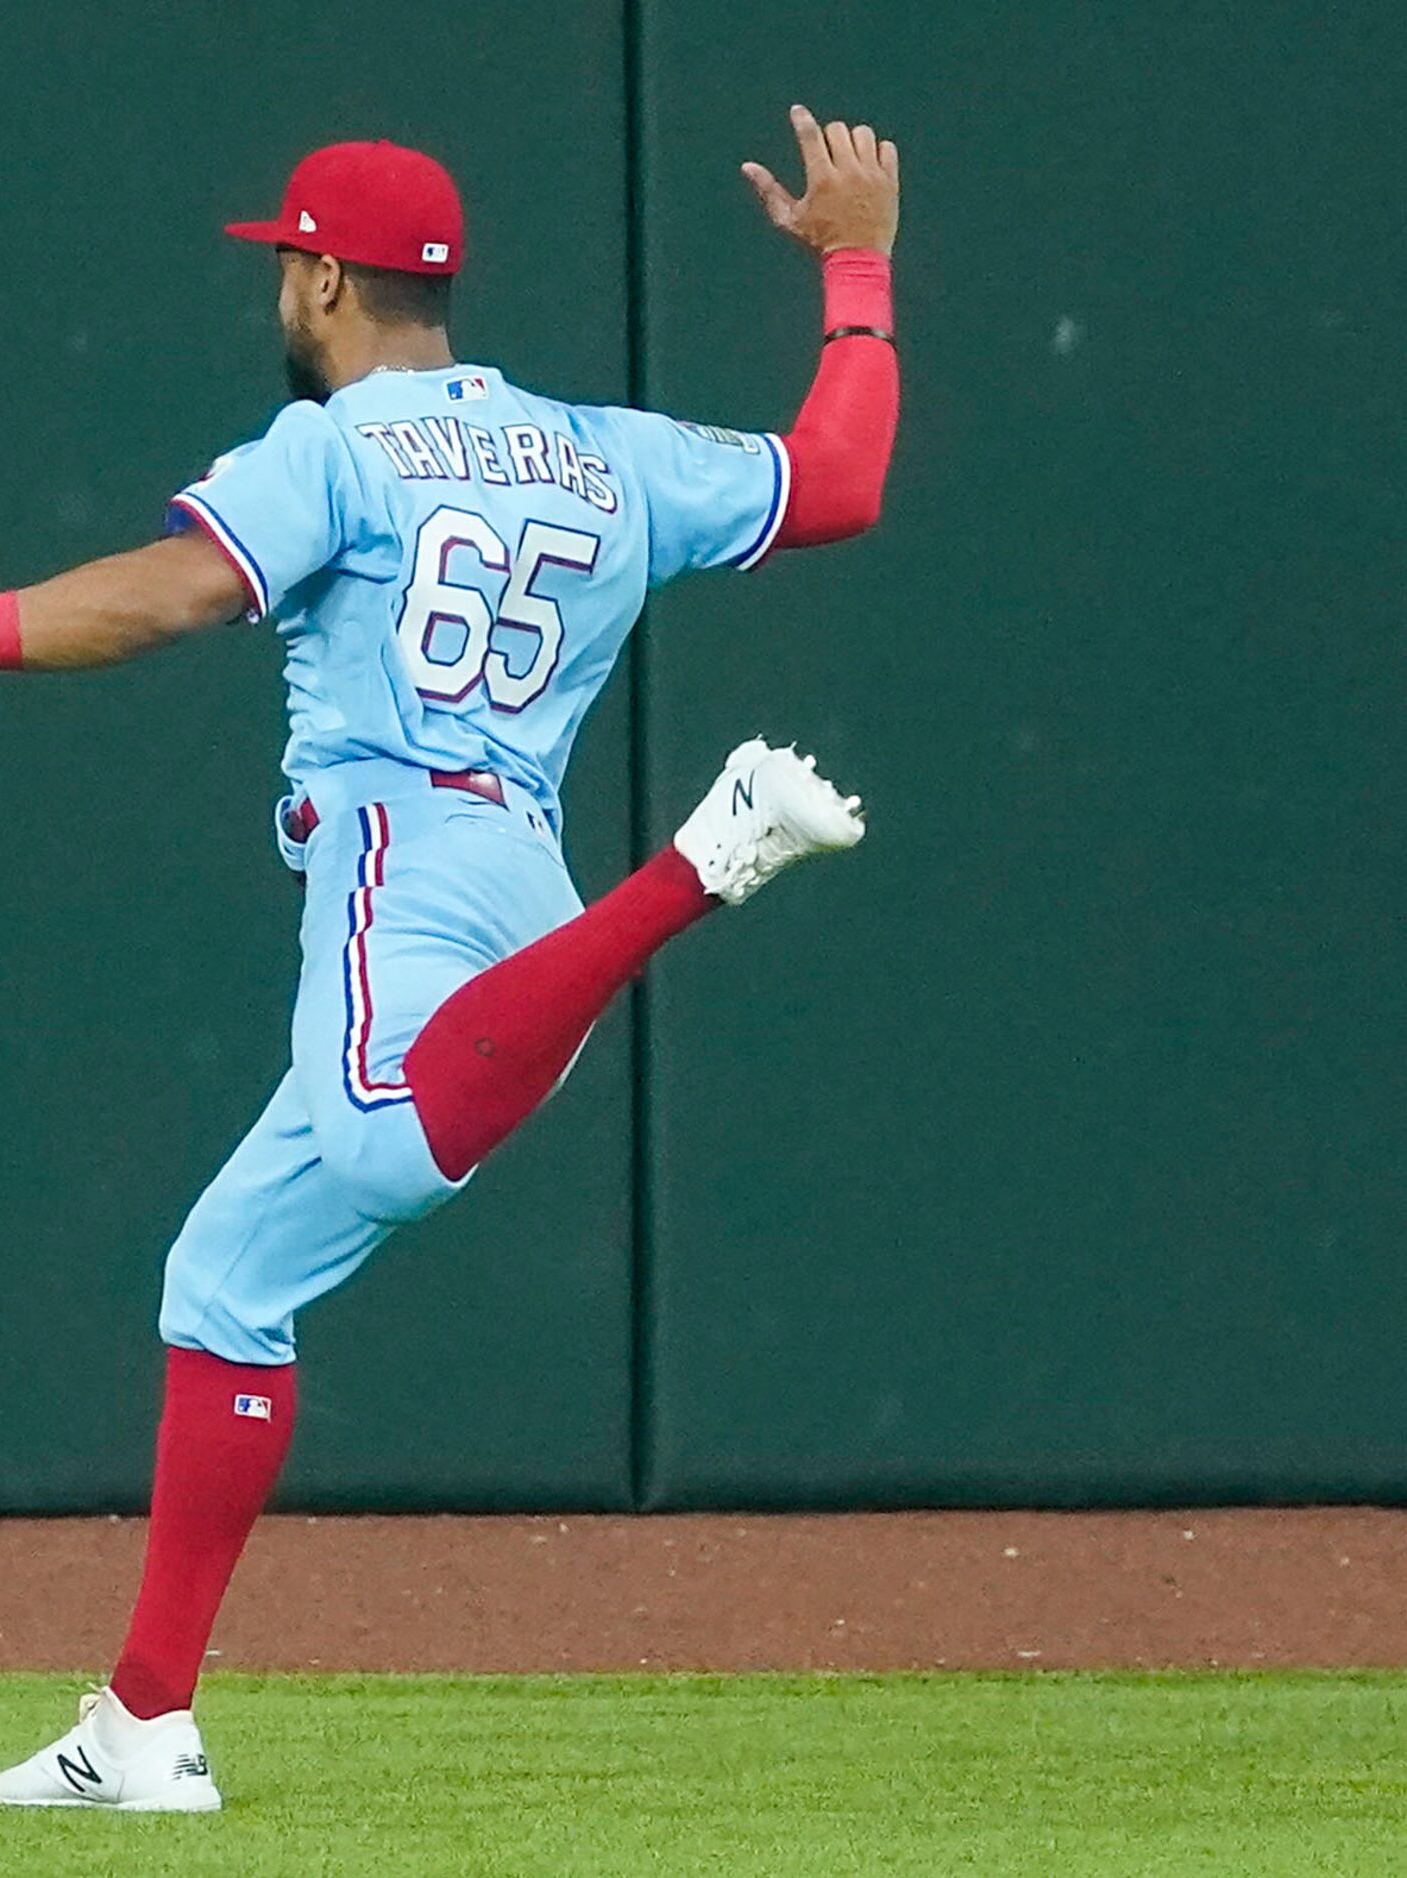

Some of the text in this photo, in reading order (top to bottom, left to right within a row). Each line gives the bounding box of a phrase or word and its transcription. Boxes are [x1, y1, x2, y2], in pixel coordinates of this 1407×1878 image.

[356, 415, 617, 513] TAVERAS
[397, 504, 600, 715] 65
[732, 769, 755, 816] N
[57, 1745, 102, 1792] N
